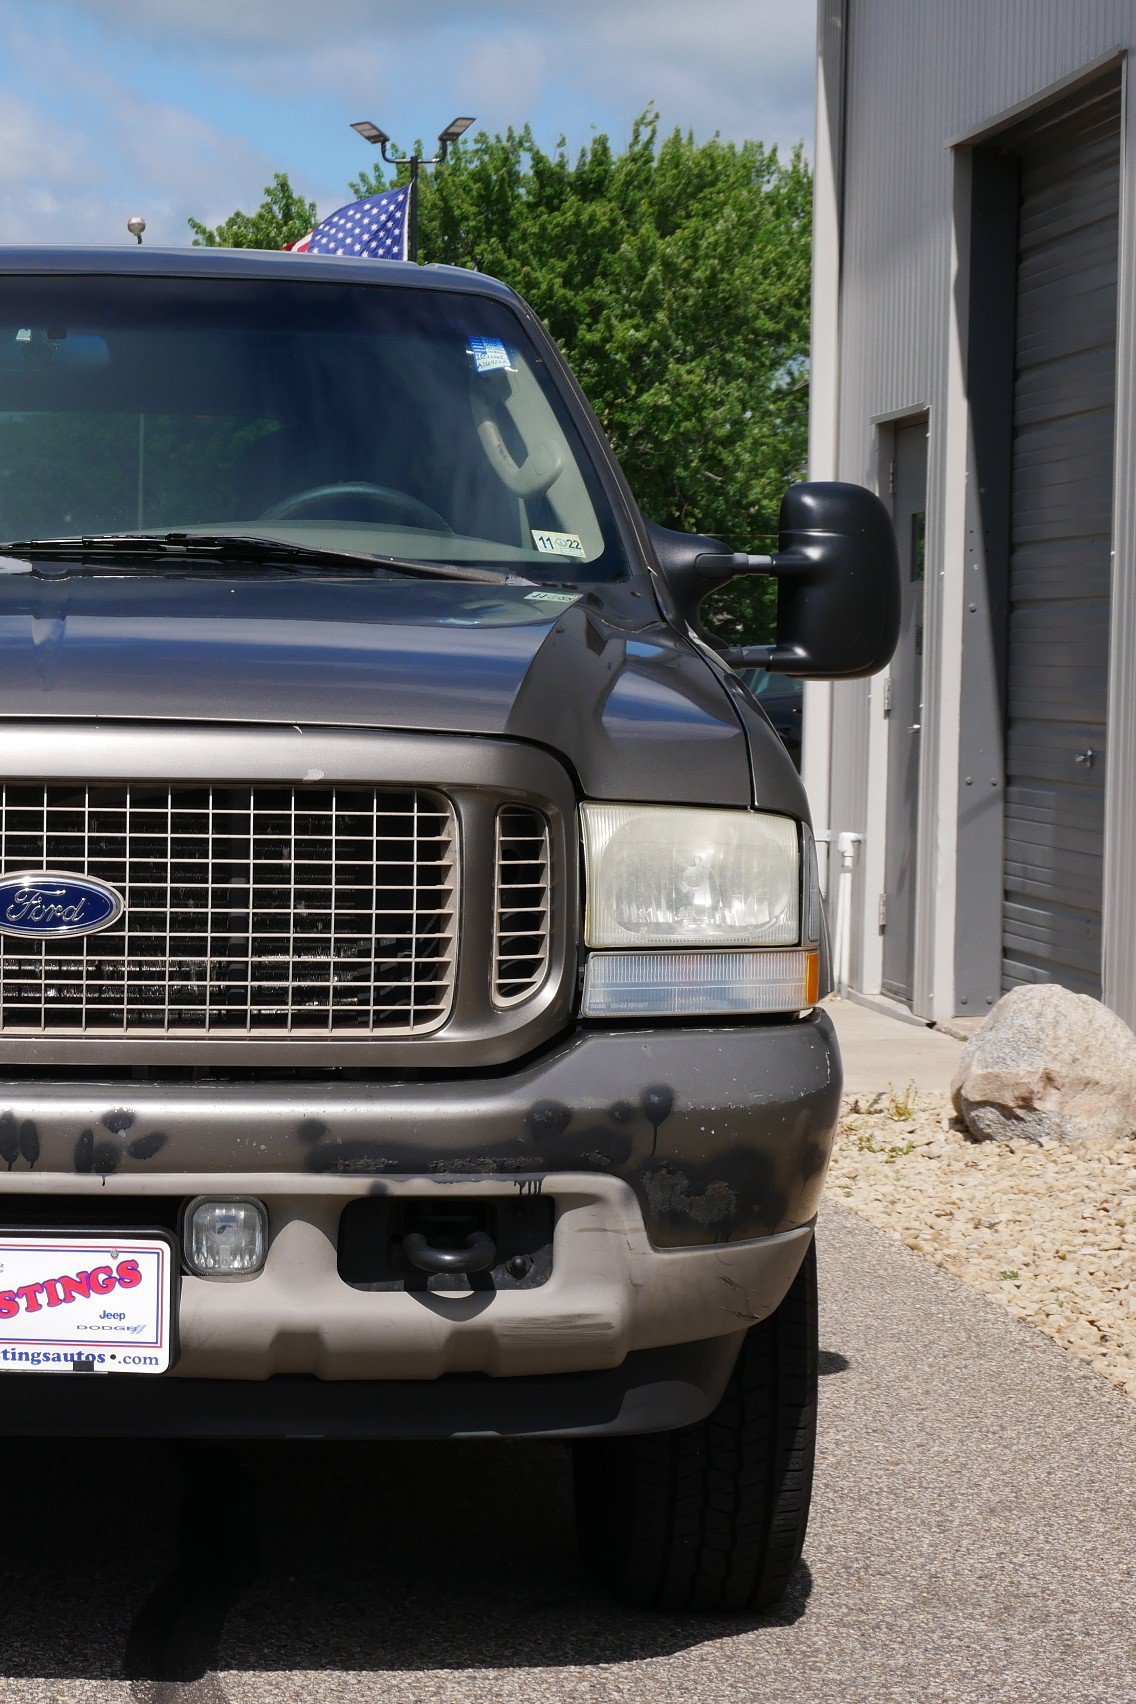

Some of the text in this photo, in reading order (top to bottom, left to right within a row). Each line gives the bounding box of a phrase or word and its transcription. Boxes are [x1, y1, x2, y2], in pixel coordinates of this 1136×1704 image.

[538, 535, 582, 550] 11 22
[6, 887, 85, 922] Ford
[99, 1309, 126, 1322] Jeep
[76, 1324, 138, 1332] DODGE
